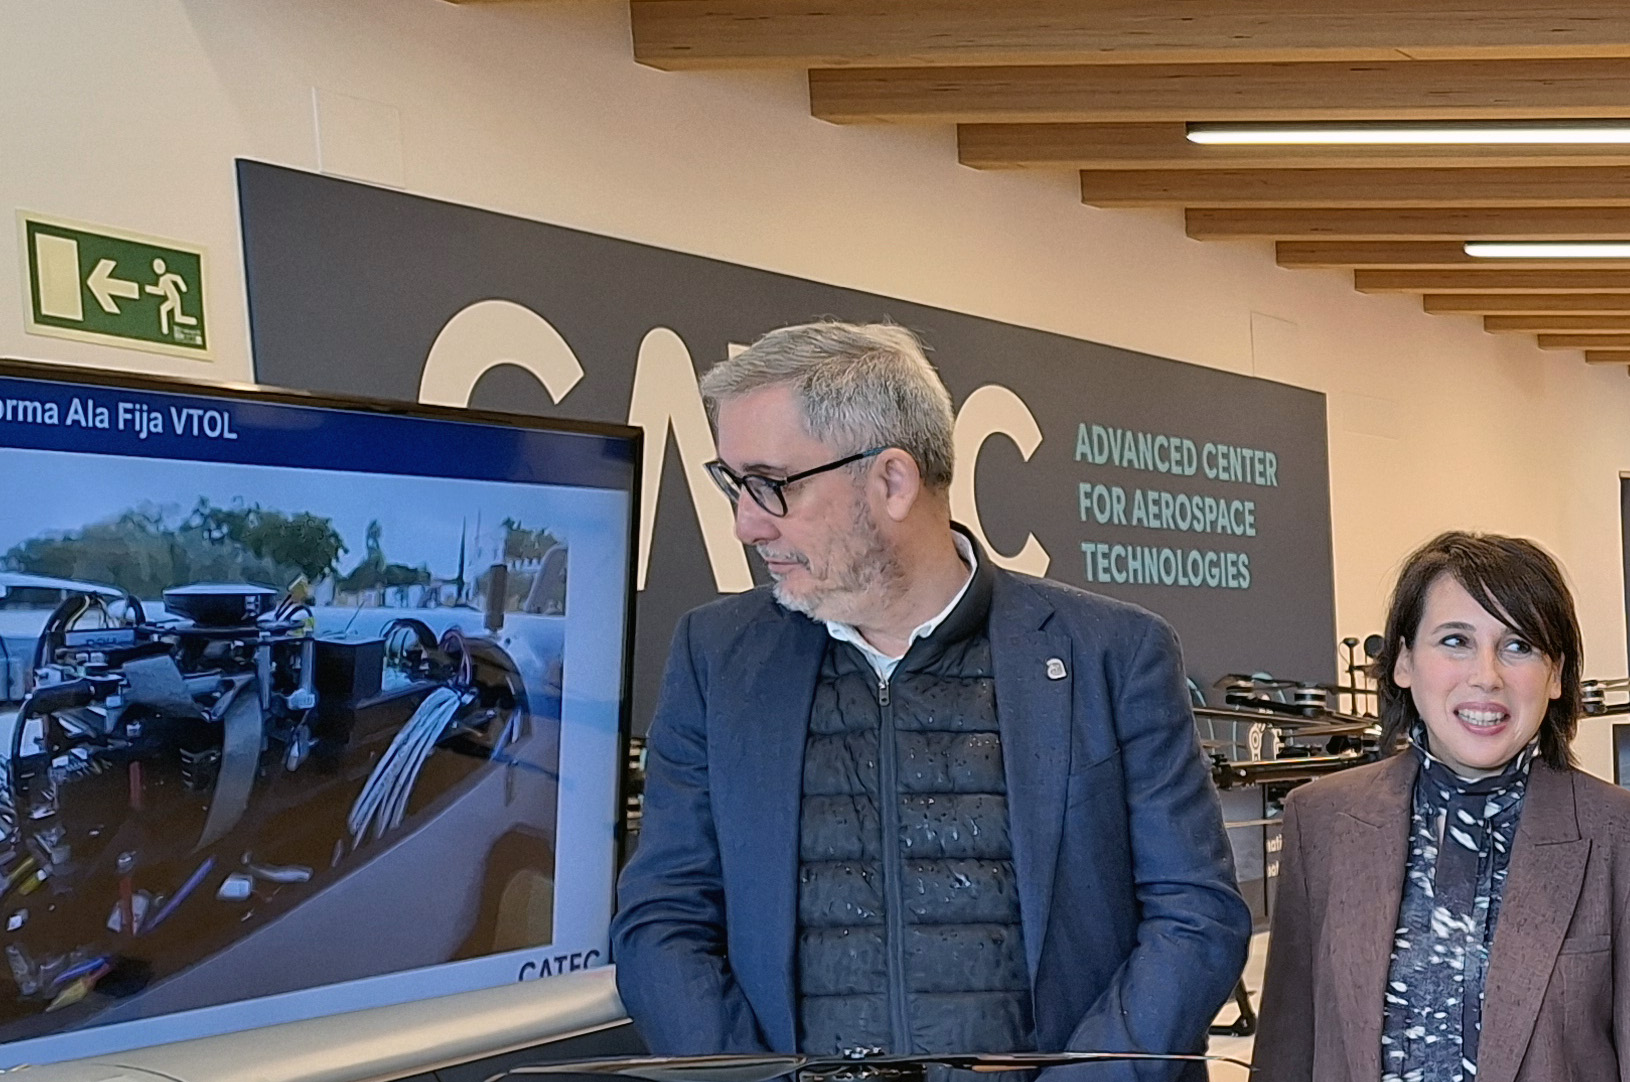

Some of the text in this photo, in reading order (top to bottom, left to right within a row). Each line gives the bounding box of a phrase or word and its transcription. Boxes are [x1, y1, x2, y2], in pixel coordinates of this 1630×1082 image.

[0, 397, 238, 440] rma Ala Fija VTOL
[1075, 422, 1279, 487] ADVANCED CENTER
[1078, 482, 1257, 537] FOR AEROSPACE
[1081, 542, 1251, 589] TECHNOLOGIES
